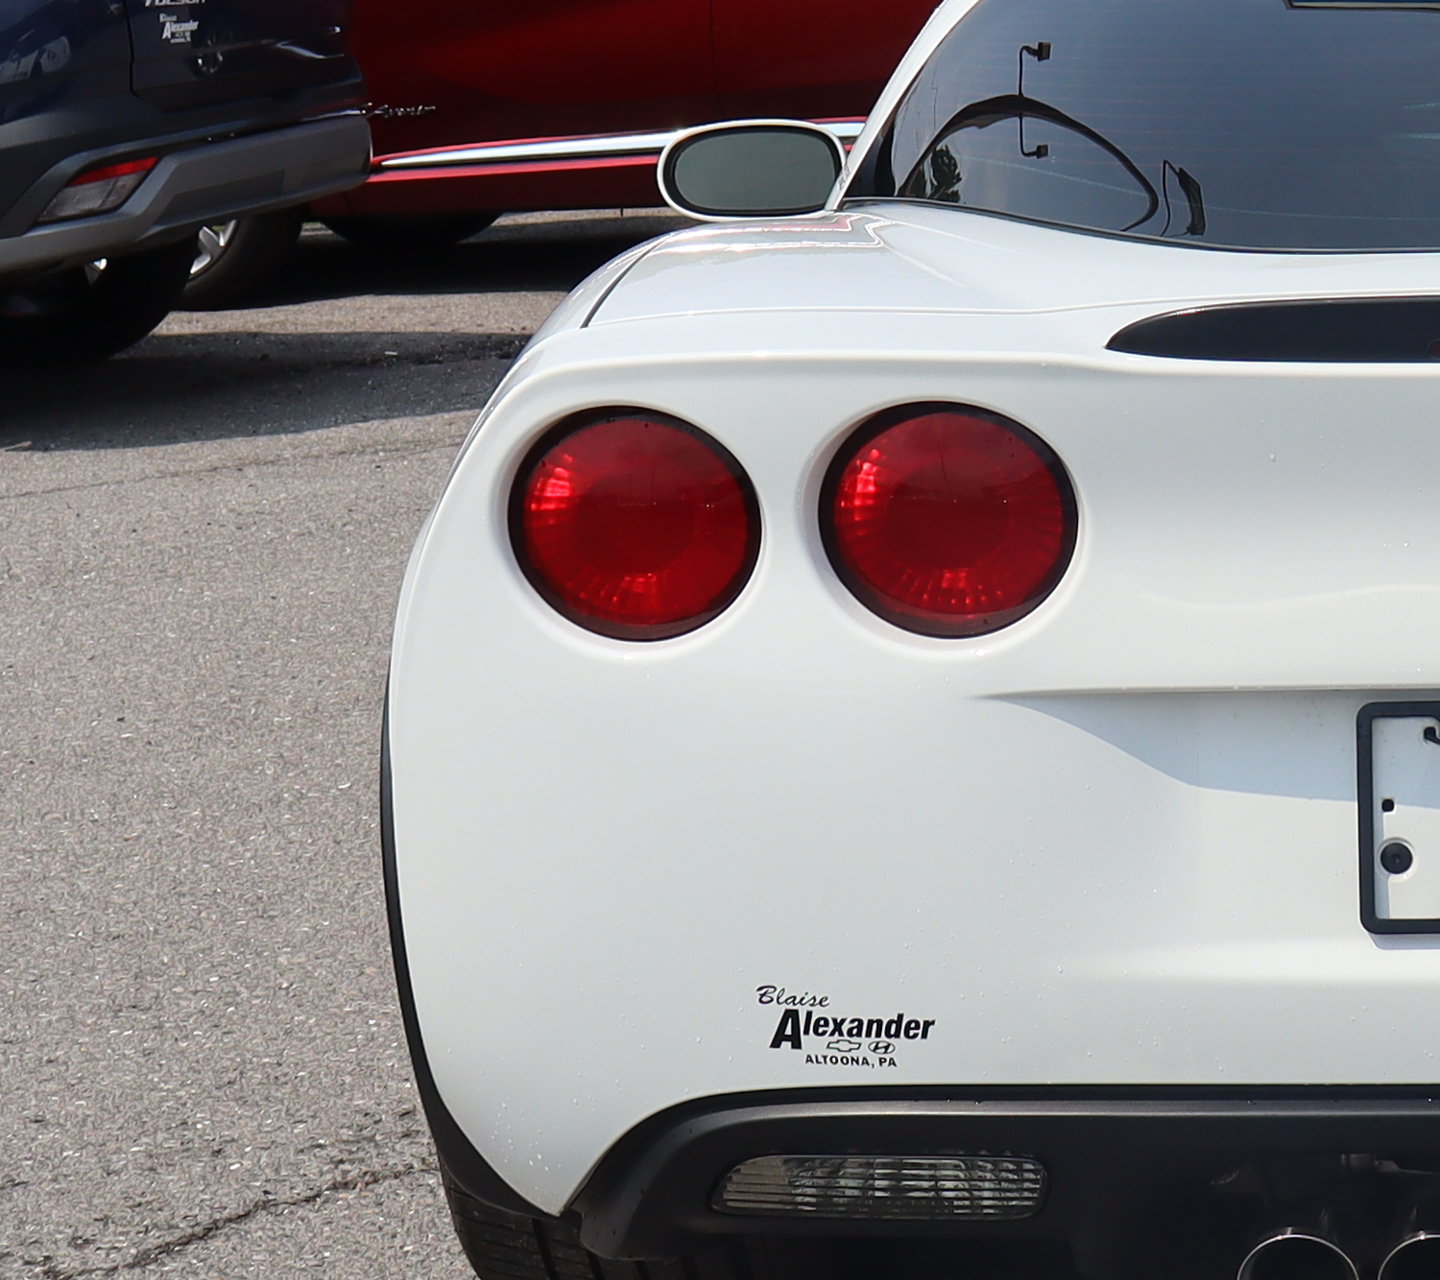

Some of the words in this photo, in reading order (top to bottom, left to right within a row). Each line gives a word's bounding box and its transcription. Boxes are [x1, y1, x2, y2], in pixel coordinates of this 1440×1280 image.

[756, 985, 830, 1007] Blaise
[769, 1008, 936, 1050] Alexander
[805, 1054, 875, 1069] ALTOONA,
[878, 1057, 897, 1068] PA
